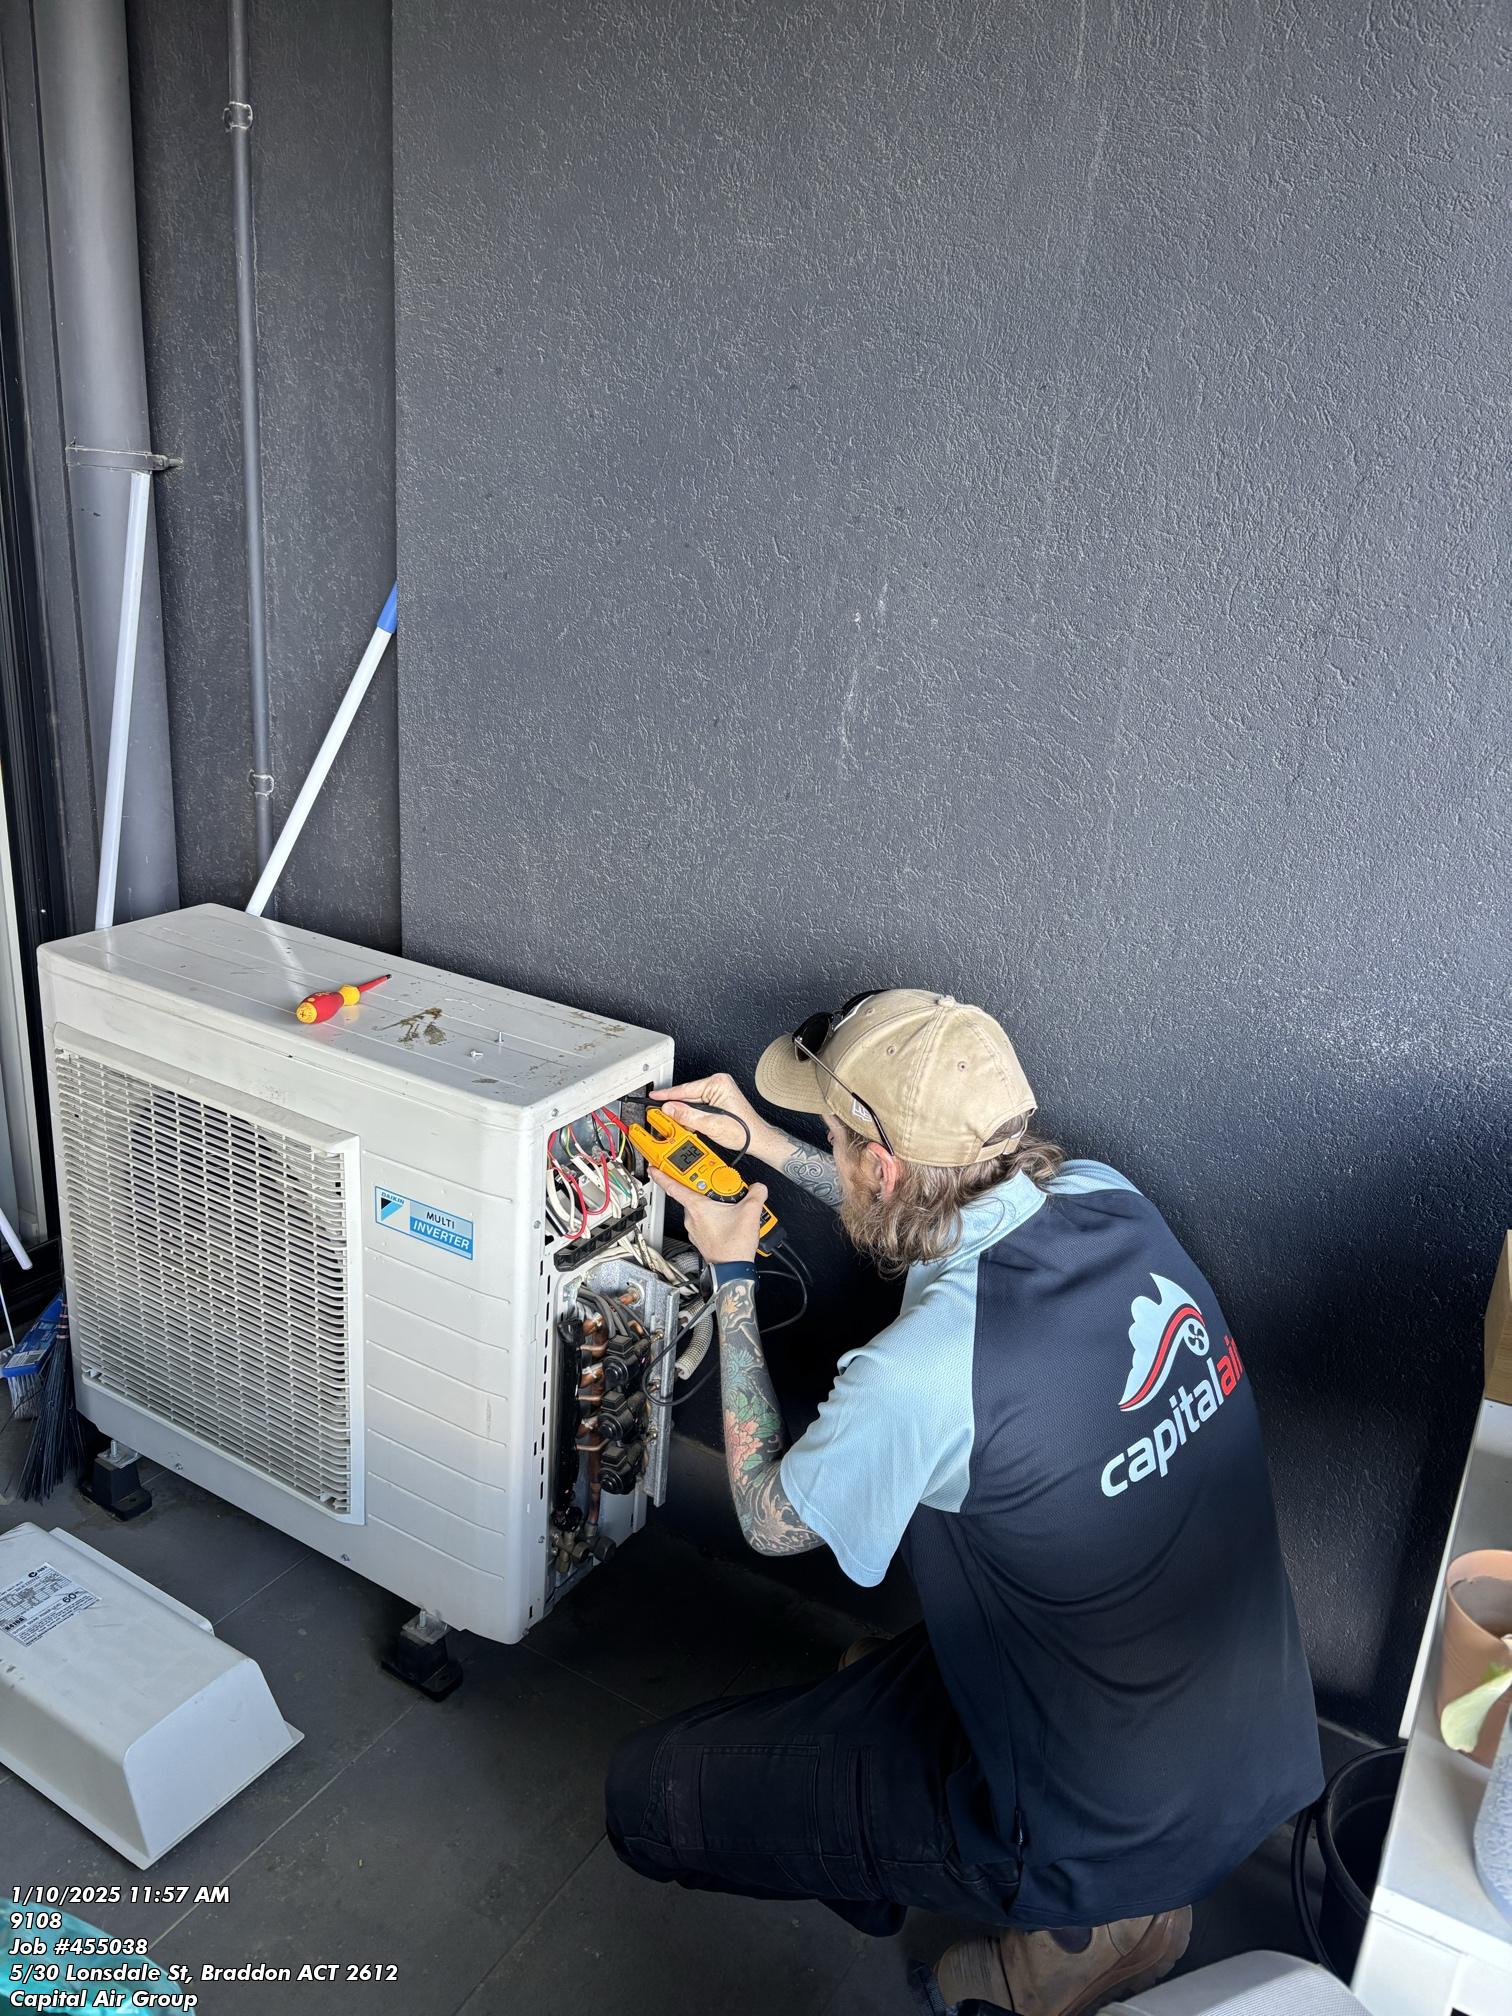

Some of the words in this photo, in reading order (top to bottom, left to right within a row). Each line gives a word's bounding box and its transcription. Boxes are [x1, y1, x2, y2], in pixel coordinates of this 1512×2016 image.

[381, 1191, 405, 1205] DAIKIN
[426, 1211, 455, 1229] MULTI
[413, 1220, 470, 1250] INVERTER
